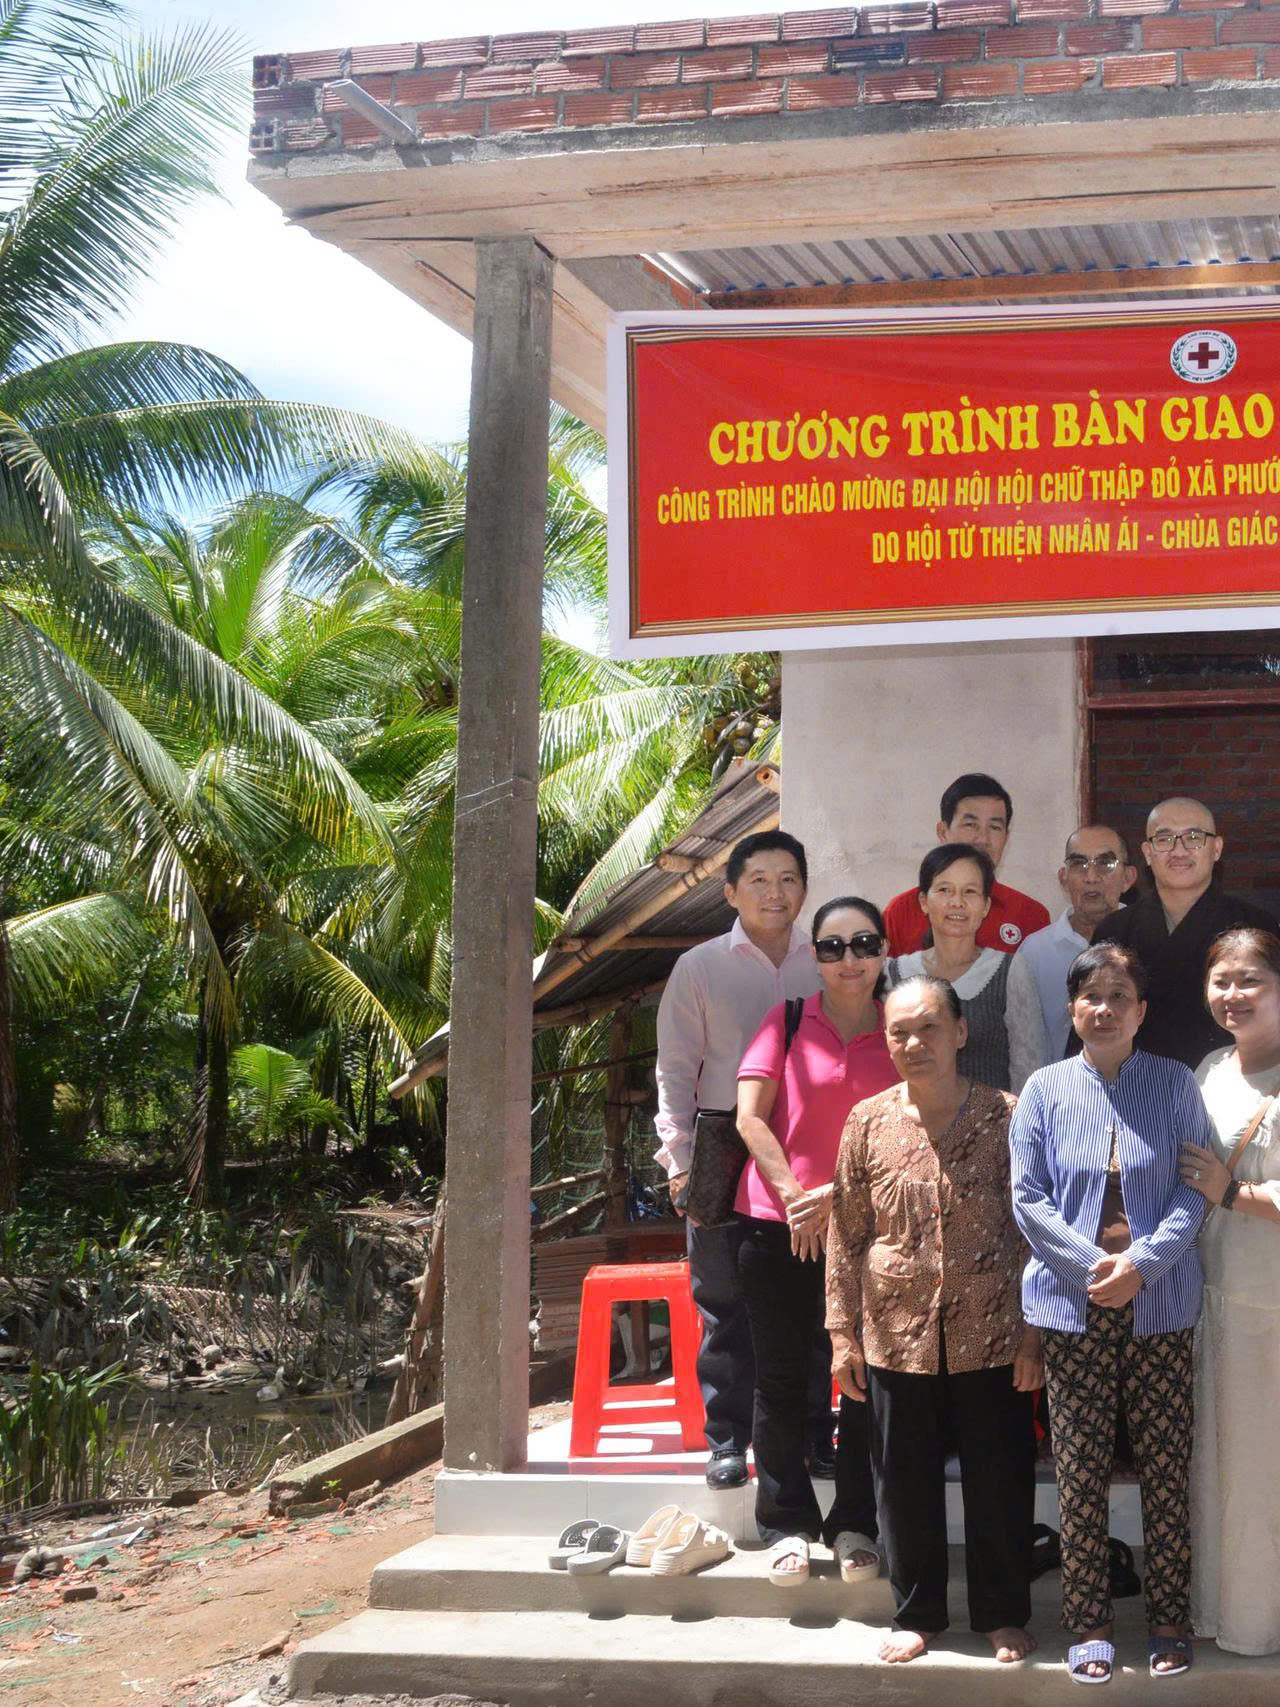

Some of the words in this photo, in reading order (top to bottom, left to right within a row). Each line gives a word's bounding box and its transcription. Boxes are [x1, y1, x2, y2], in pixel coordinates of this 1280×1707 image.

[709, 410, 890, 465] CHƯƠNG
[902, 396, 1040, 456] TRÌNH
[1052, 389, 1146, 448] BÀN
[1161, 393, 1274, 442] GIAO
[658, 487, 710, 524] CÔNG
[716, 481, 774, 519] TRÌNH
[782, 476, 835, 515] CHÀO
[843, 474, 905, 511] MỪNG
[912, 478, 948, 512] ĐẠI
[954, 470, 990, 512] HỘI
[998, 468, 1032, 511] HỘI
[1040, 465, 1085, 503] CHỮ
[1089, 463, 1144, 506] THẬP
[1151, 456, 1180, 498] ĐỎ
[1187, 459, 1217, 496] XÃ
[872, 531, 899, 563] DO
[907, 523, 941, 567] HỘI
[948, 521, 976, 558] TỪ
[980, 520, 1042, 562] THIỆN
[1049, 517, 1110, 554] NHÂN
[1117, 516, 1139, 551] ÁI
[1161, 513, 1220, 550] CHÙA
[1227, 512, 1278, 547] GIÁC
